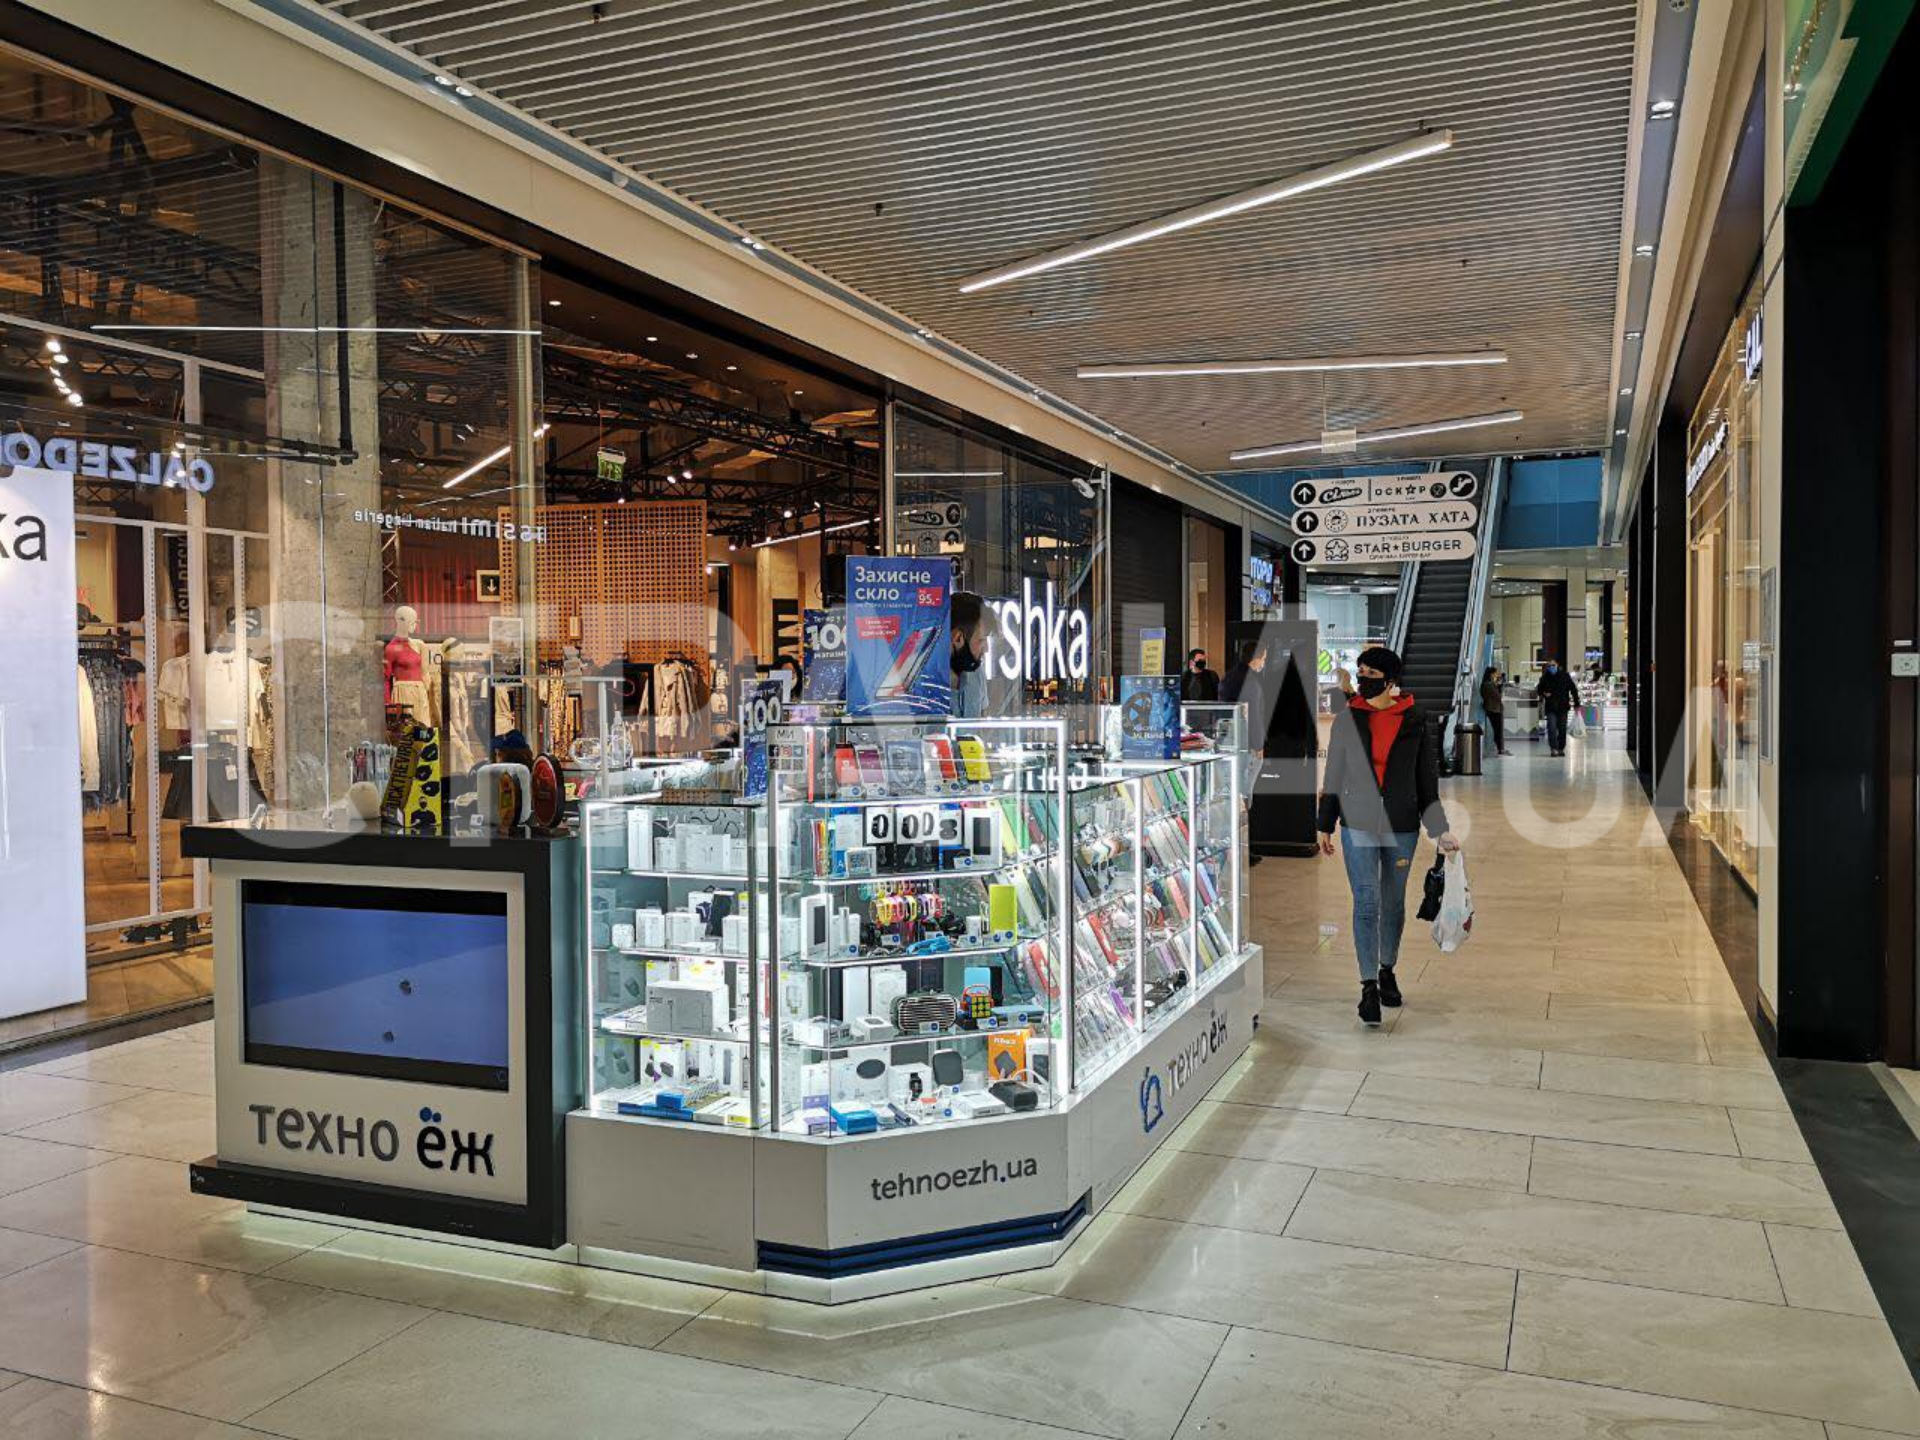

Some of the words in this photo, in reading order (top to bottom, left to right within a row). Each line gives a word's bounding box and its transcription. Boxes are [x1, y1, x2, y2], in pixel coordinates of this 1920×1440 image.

[0, 513, 47, 561] a
[1356, 514, 1420, 528] ПУЗАТА
[1428, 511, 1471, 524] ХАТА
[1353, 542, 1391, 555] STAR
[1401, 539, 1463, 553] BURGER
[855, 566, 931, 584] Захисне
[855, 588, 900, 601] скло
[984, 577, 1089, 680] rshka
[744, 696, 781, 733] 100
[1166, 1030, 1208, 1099] техно
[248, 1104, 399, 1162] техно
[416, 1107, 495, 1176] ёж
[870, 1154, 1039, 1201] tehnoezh.ua
